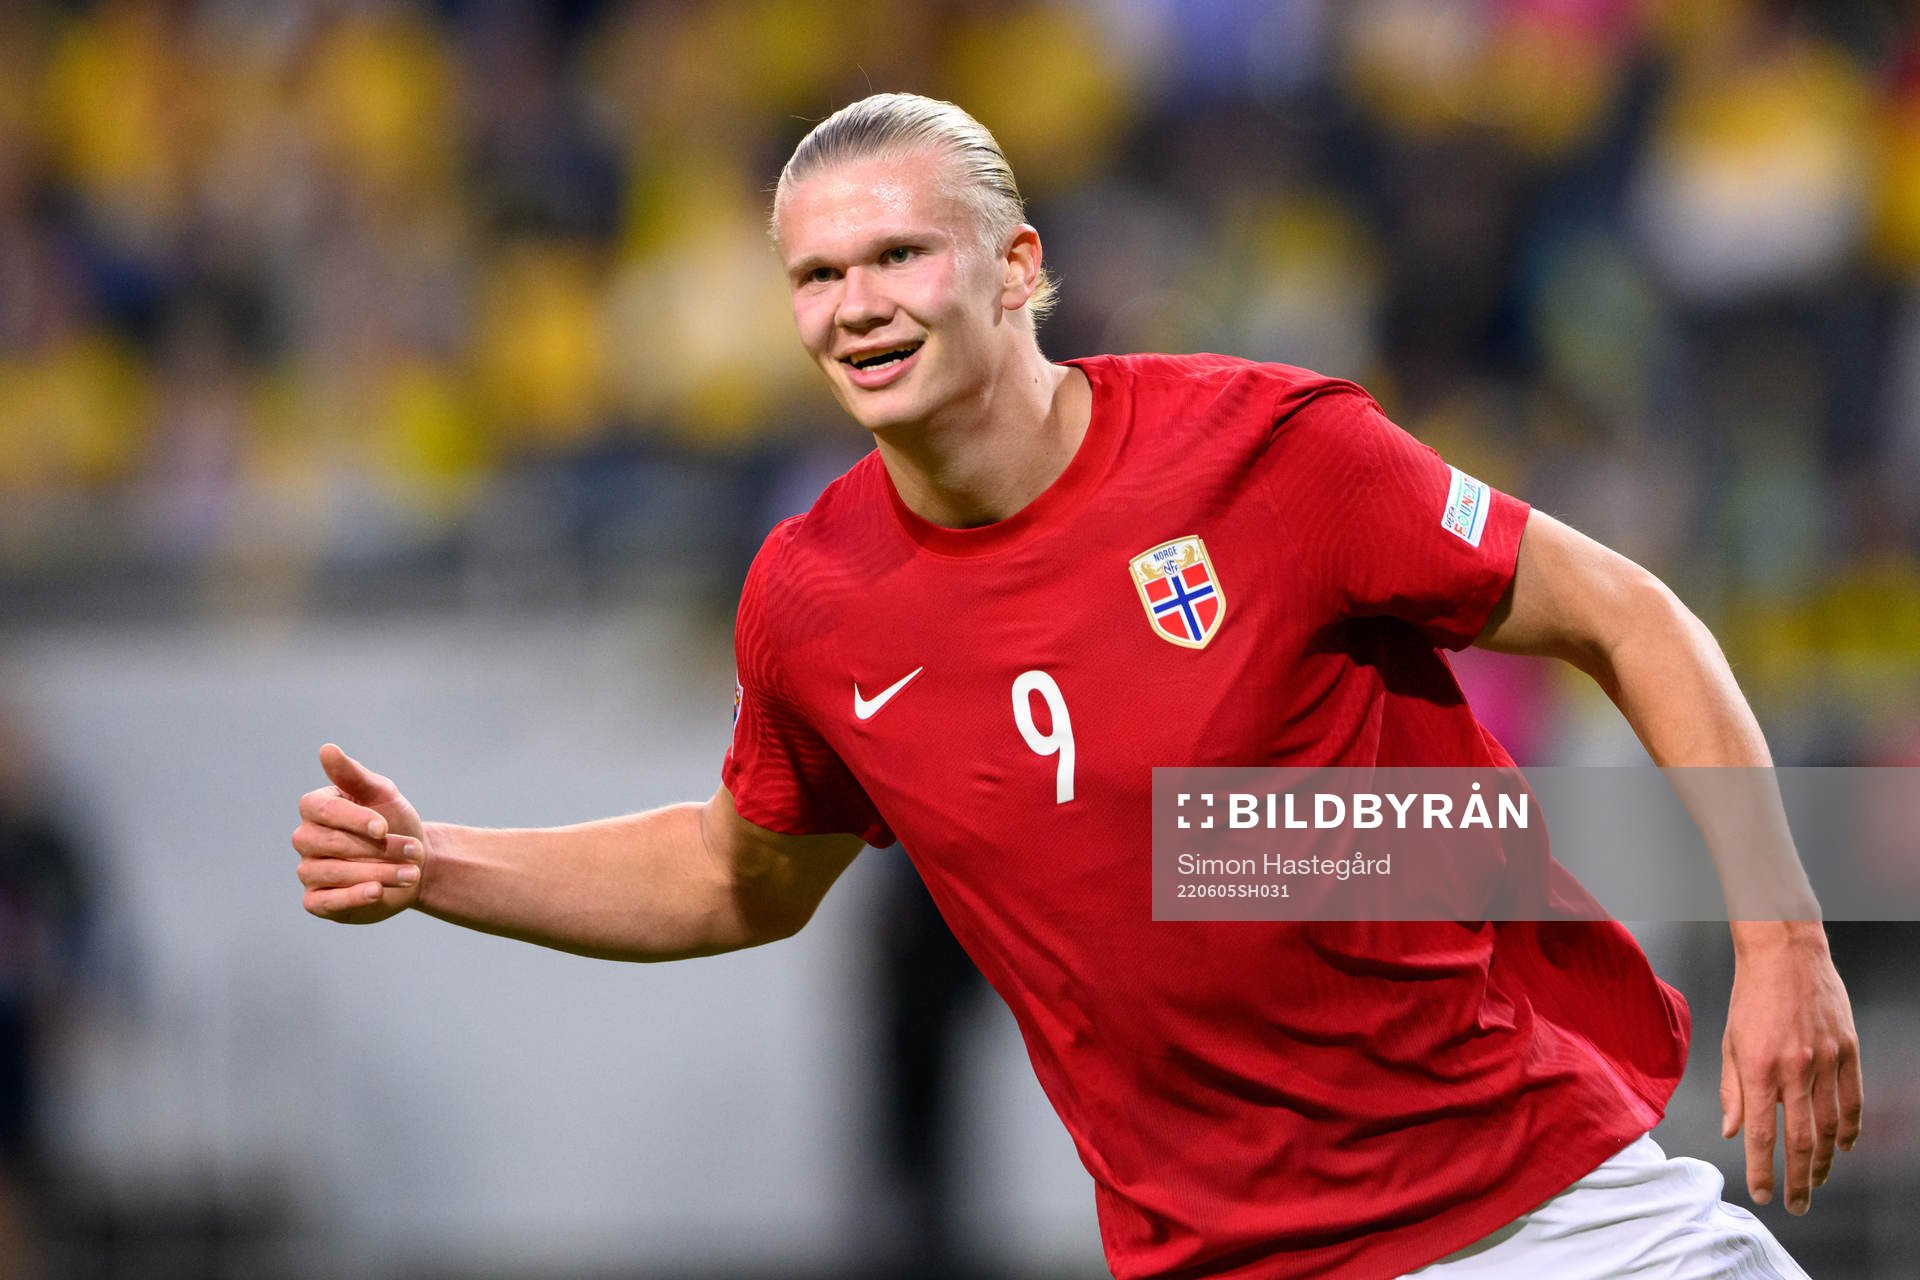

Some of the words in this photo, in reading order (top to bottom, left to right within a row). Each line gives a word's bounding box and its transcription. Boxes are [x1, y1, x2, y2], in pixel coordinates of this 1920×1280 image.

[1445, 506, 1457, 528] UEFA
[1153, 546, 1178, 562] NORGE
[1011, 669, 1075, 805] 9
